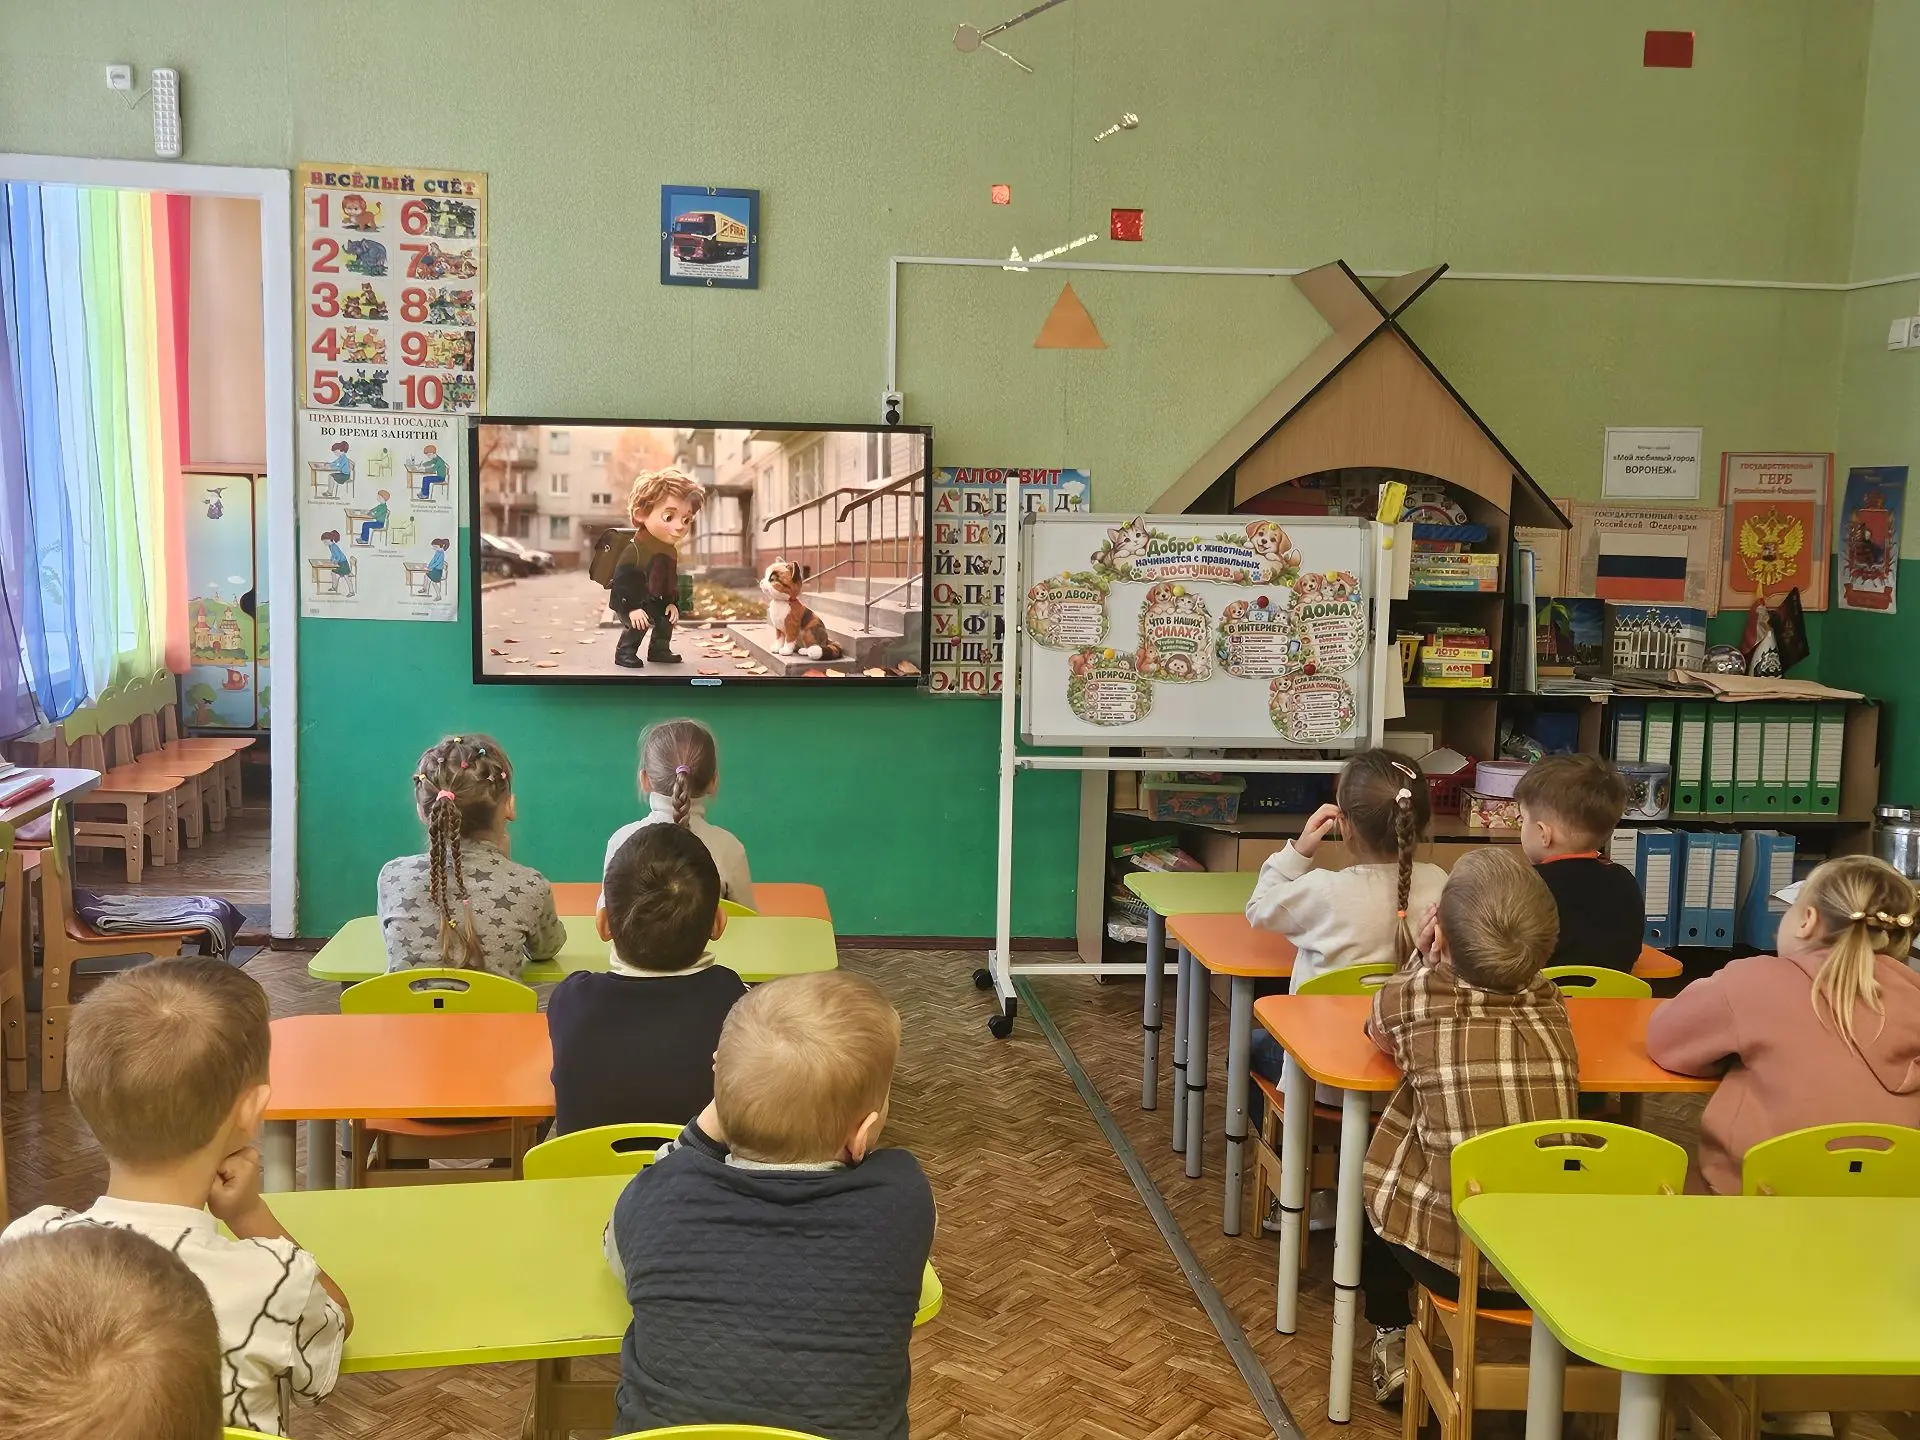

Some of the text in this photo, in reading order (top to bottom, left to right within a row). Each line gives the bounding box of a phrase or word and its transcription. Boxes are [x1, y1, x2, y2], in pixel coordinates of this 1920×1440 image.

[311, 171, 476, 195] ВЕСЁЛЫЙ СЧЁТ
[706, 187, 717, 195] 12
[312, 193, 329, 228] 1
[401, 200, 428, 236] 6
[661, 231, 668, 240] 9
[751, 235, 757, 243] 3
[312, 238, 340, 273] 2
[400, 243, 428, 278] 7
[706, 278, 713, 286] 6
[311, 281, 340, 318] 3
[400, 287, 428, 323] 8
[312, 327, 340, 361] 4
[401, 331, 428, 366] 9
[312, 369, 340, 405] 5
[399, 375, 444, 410] 10
[309, 413, 449, 428] ПРАВИЛЬНАЯ ПОСАДКА
[320, 427, 438, 440] ВО ВРЕМЯ ЗАНЯТИЙ
[1759, 473, 1793, 485] ГЕРБ
[935, 492, 954, 513] А
[1024, 494, 1041, 513] Г
[1054, 493, 1070, 513] Д
[1146, 537, 1194, 557] Добро
[1204, 545, 1253, 558] животным
[934, 549, 954, 575] Й
[964, 555, 983, 575] К
[1135, 555, 1191, 567] начинается
[1202, 556, 1260, 569] правильных
[1160, 564, 1234, 579] поступков.
[933, 583, 953, 604] О
[963, 585, 984, 604] П
[1049, 590, 1098, 601] ВО ДВОРЕ
[1149, 617, 1164, 627] ЧТО
[1174, 616, 1202, 627] НАШИХ
[1301, 603, 1350, 621] ДОМА
[933, 614, 953, 634] У
[963, 615, 985, 634] Ф
[1155, 626, 1200, 639] СИЛАХ?
[1229, 624, 1288, 633] В ИНТЕРНЕТЕ
[1096, 671, 1137, 680] ПРИРОДЕ
